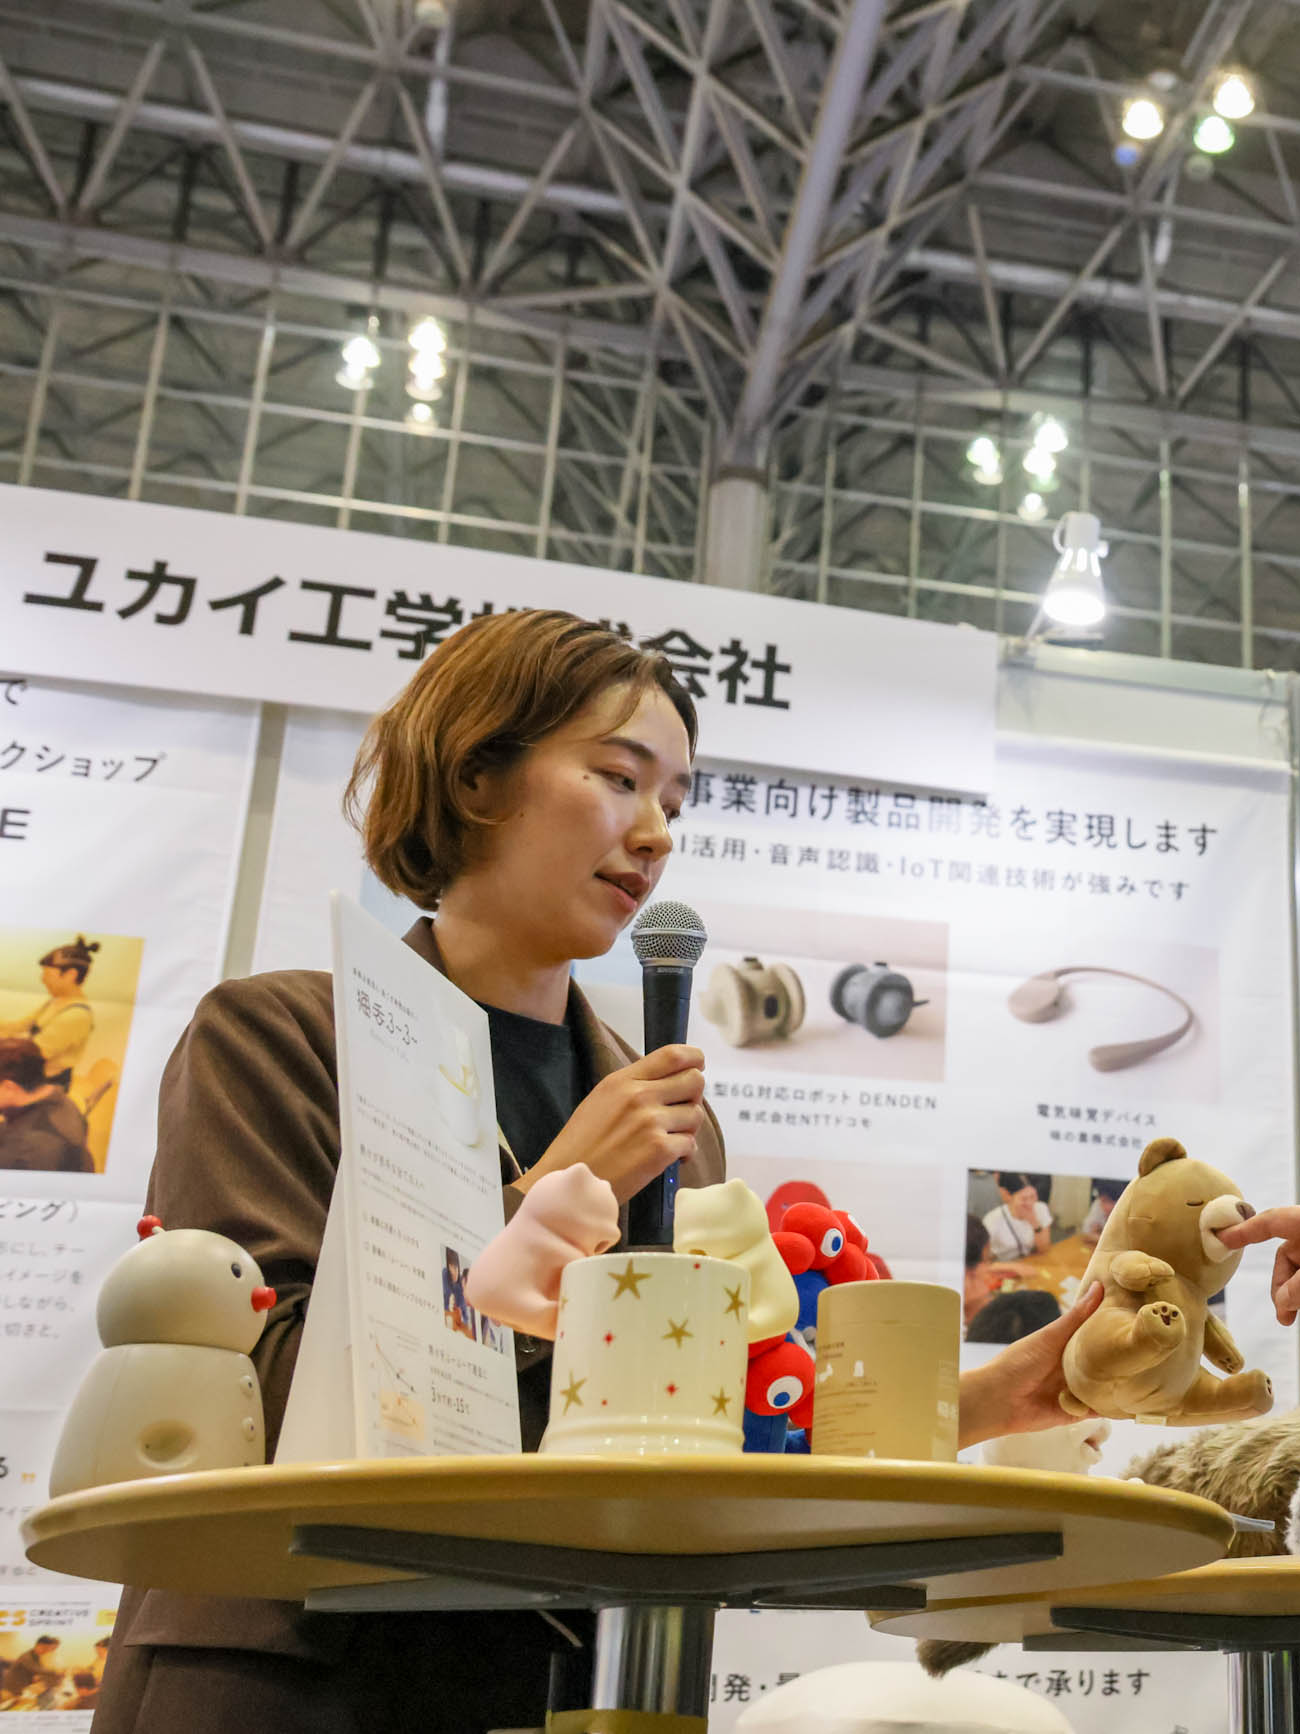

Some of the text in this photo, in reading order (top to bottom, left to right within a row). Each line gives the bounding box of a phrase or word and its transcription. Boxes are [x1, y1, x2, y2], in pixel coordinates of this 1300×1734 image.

[23, 550, 792, 711] ユカイ工学会社
[0, 740, 168, 782] クショップ
[687, 769, 1219, 856] 事業向け製品開発を実現します
[674, 832, 1190, 901] I活用・音声認識・IoT関連技術が強みです
[707, 1082, 938, 1110] 型6G対応ロボット DENDEN
